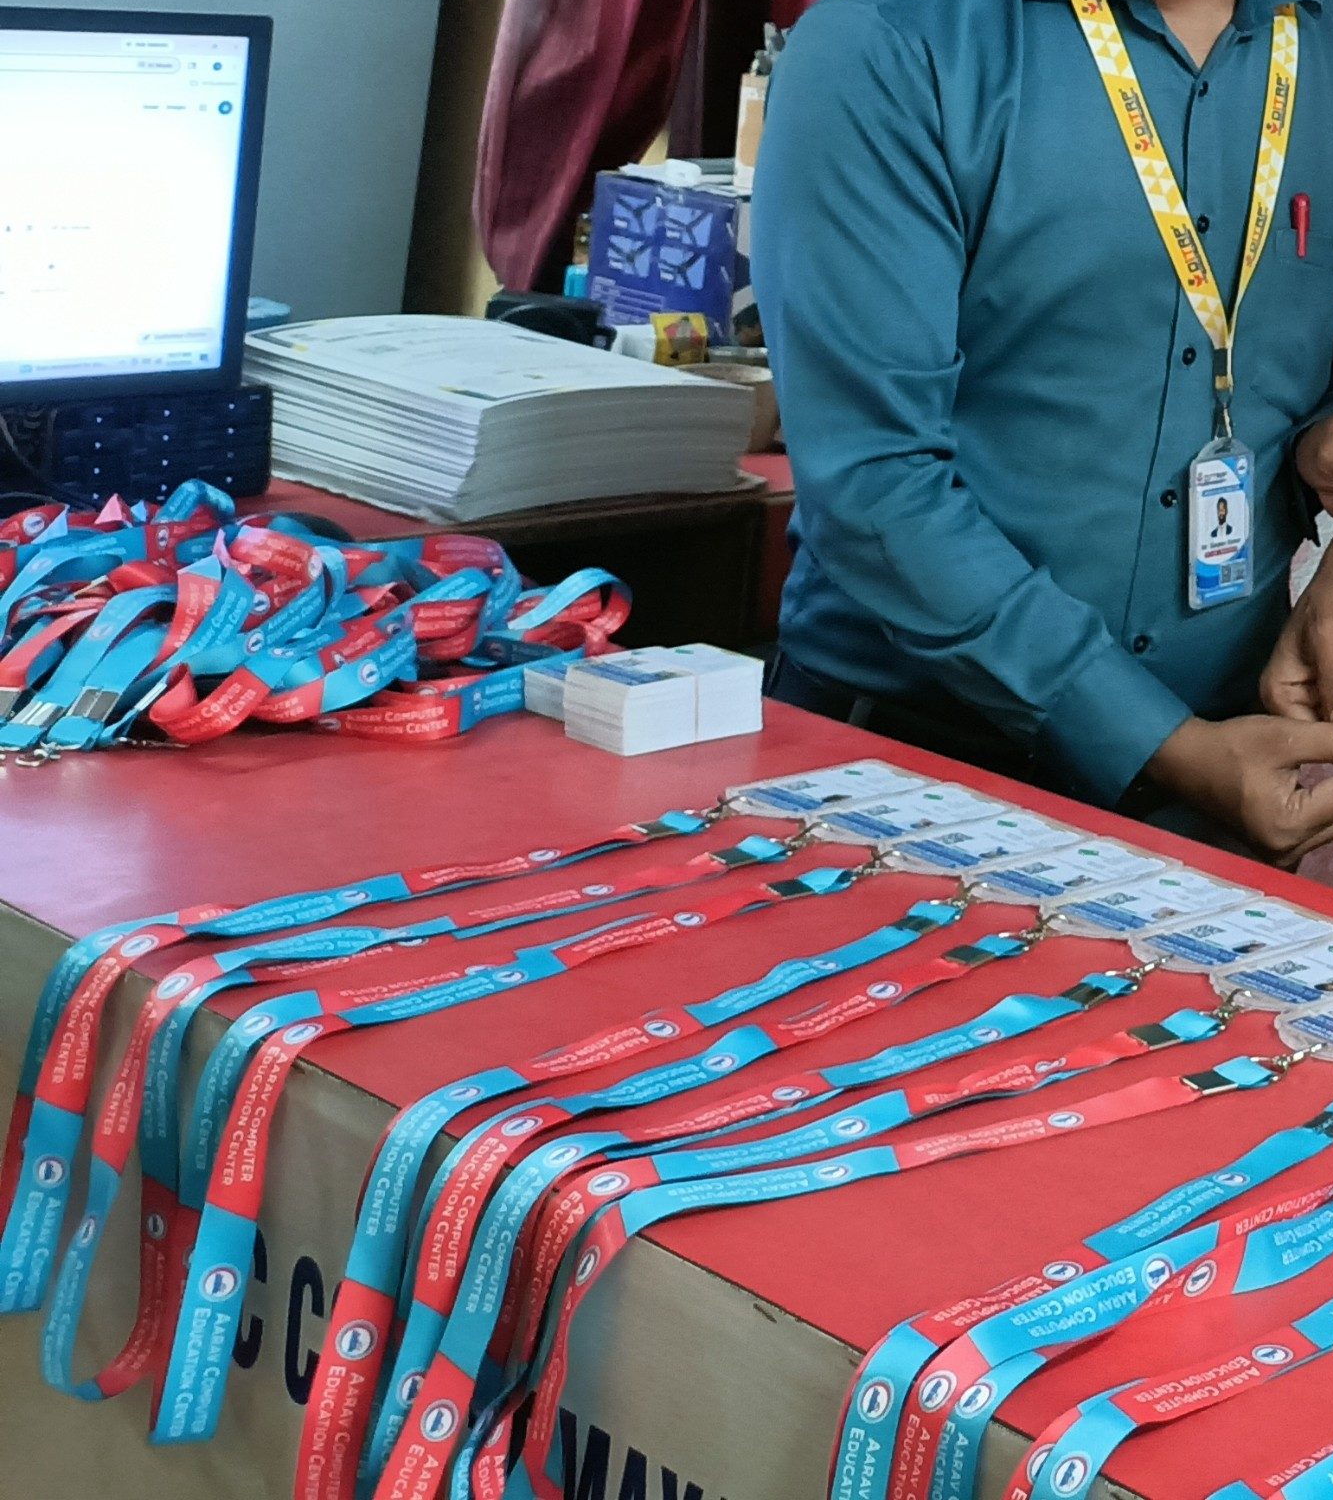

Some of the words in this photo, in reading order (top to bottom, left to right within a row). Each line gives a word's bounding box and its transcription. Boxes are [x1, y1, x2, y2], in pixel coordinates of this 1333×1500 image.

[241, 1047, 280, 1128] EDUCATION
[261, 1052, 288, 1108] AARAV
[222, 1129, 244, 1186] CENTER
[240, 1107, 267, 1183] COMPUTER
[447, 1136, 499, 1216] EDUCATION
[466, 1142, 508, 1196] AARAV
[427, 1218, 452, 1282] CENTER
[445, 1195, 478, 1280] COMPUTER
[1063, 1266, 1136, 1304] EDUCATION
[1099, 1289, 1137, 1317] AARAV
[1012, 1303, 1060, 1326] CENTER
[1030, 1306, 1096, 1337] COMPUTER
[1136, 1378, 1184, 1403] CENTER
[1184, 1356, 1251, 1388] EDUCATION
[1217, 1368, 1261, 1393] AARAV
[1153, 1385, 1219, 1413] COMPUTER
